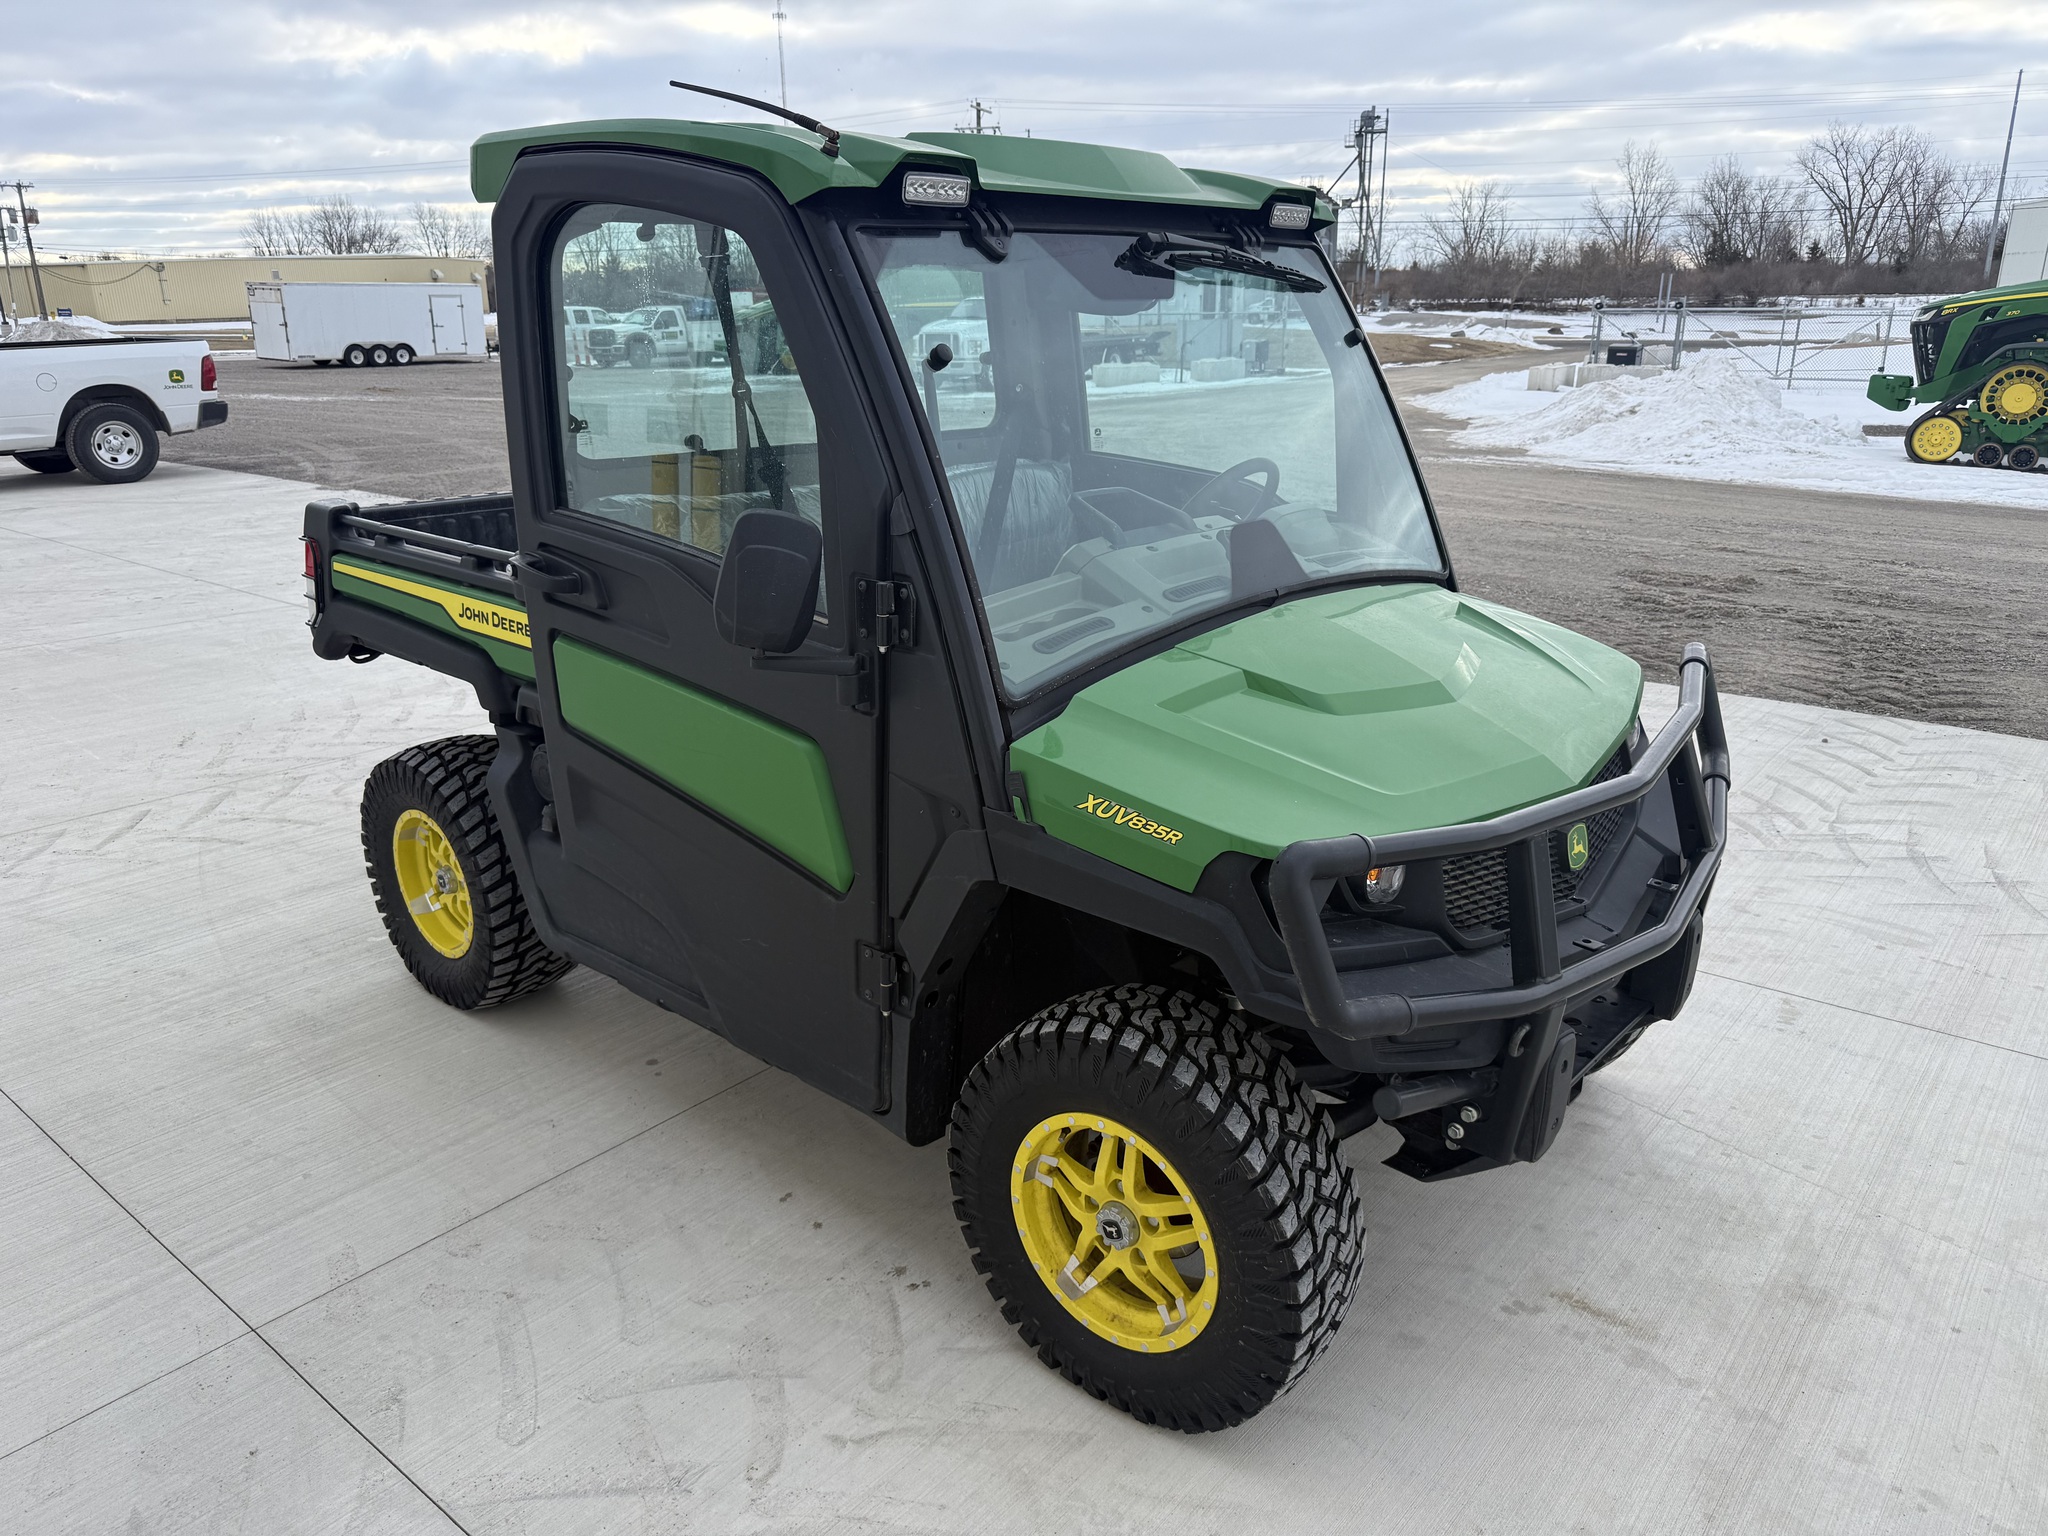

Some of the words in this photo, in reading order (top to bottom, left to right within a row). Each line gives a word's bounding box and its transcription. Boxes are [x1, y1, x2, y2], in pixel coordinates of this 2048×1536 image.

[458, 603, 490, 626] JOHN
[491, 611, 531, 638] DEERE
[1074, 792, 1184, 846] XUV835R
